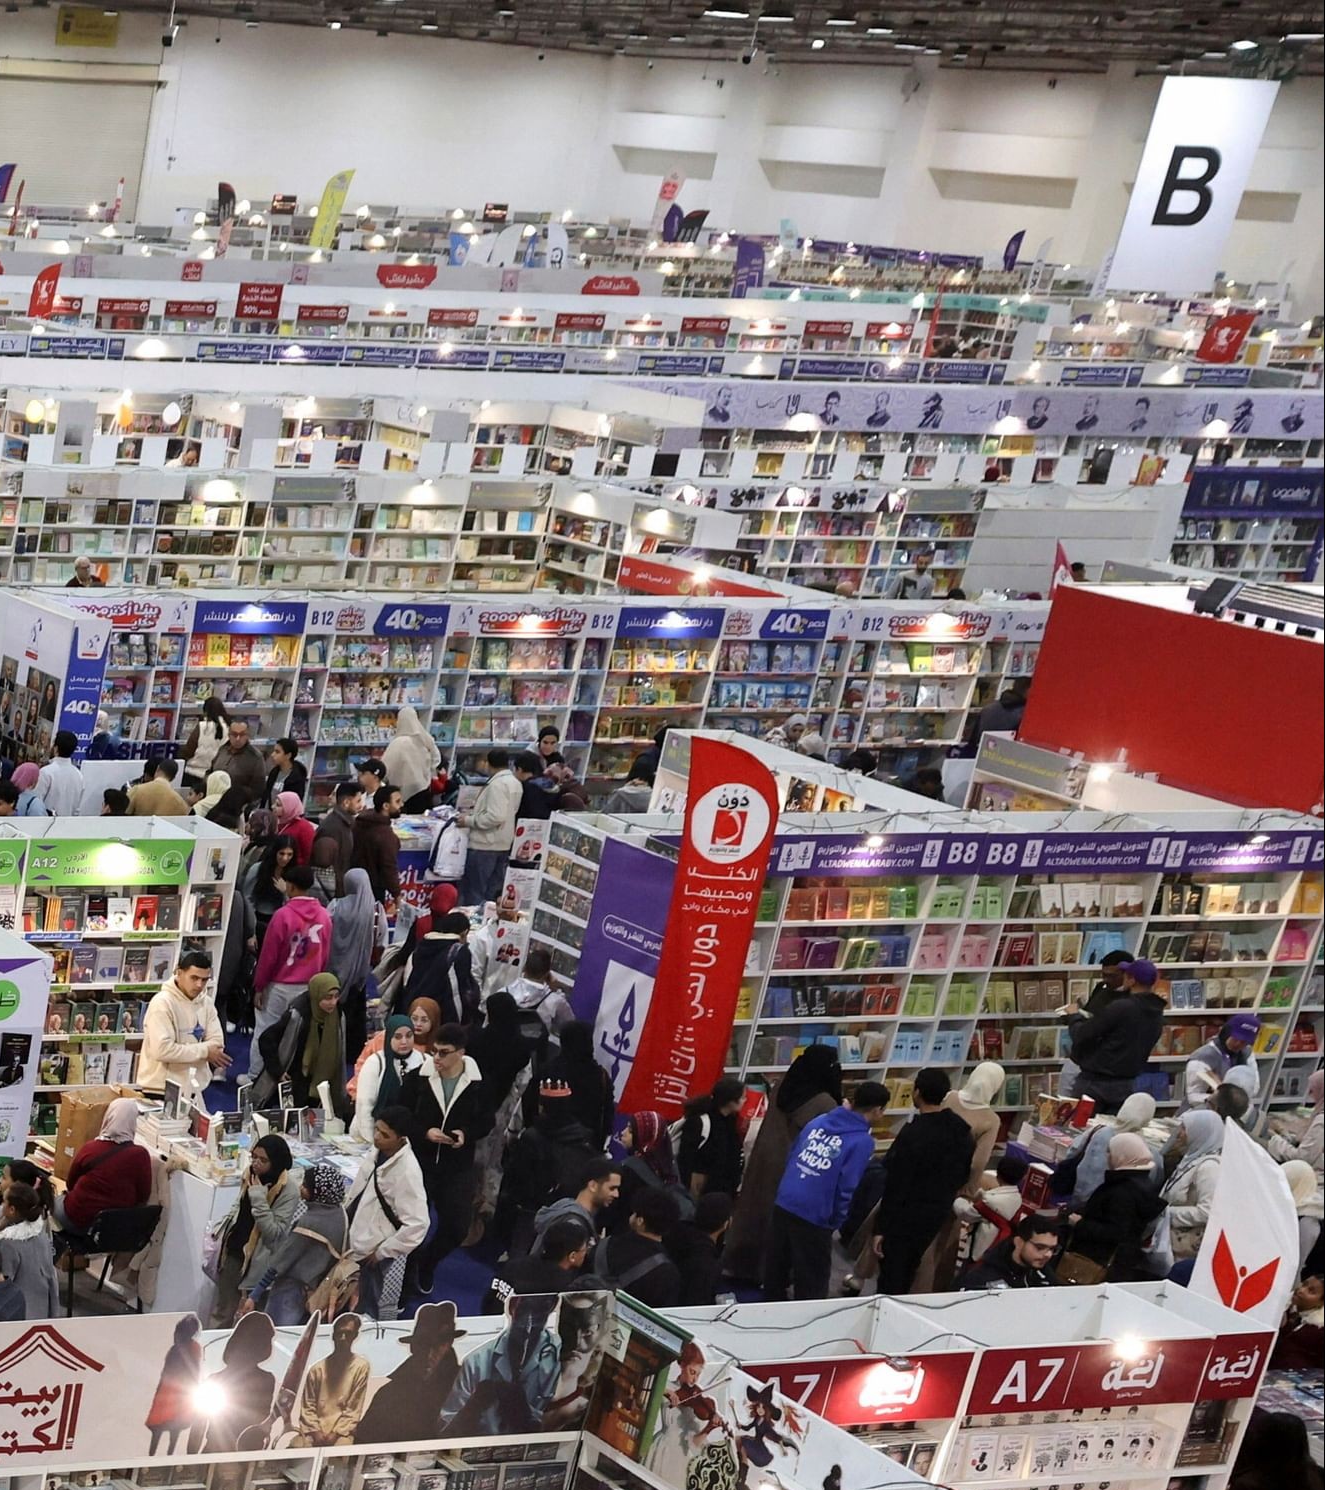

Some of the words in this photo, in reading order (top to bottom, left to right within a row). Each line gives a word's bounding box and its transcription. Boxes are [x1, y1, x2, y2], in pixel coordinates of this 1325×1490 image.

[1152, 145, 1223, 227] B
[31, 857, 59, 868] A12
[947, 841, 979, 865] B8
[985, 842, 1018, 865] B8
[991, 1357, 1065, 1404] A7
